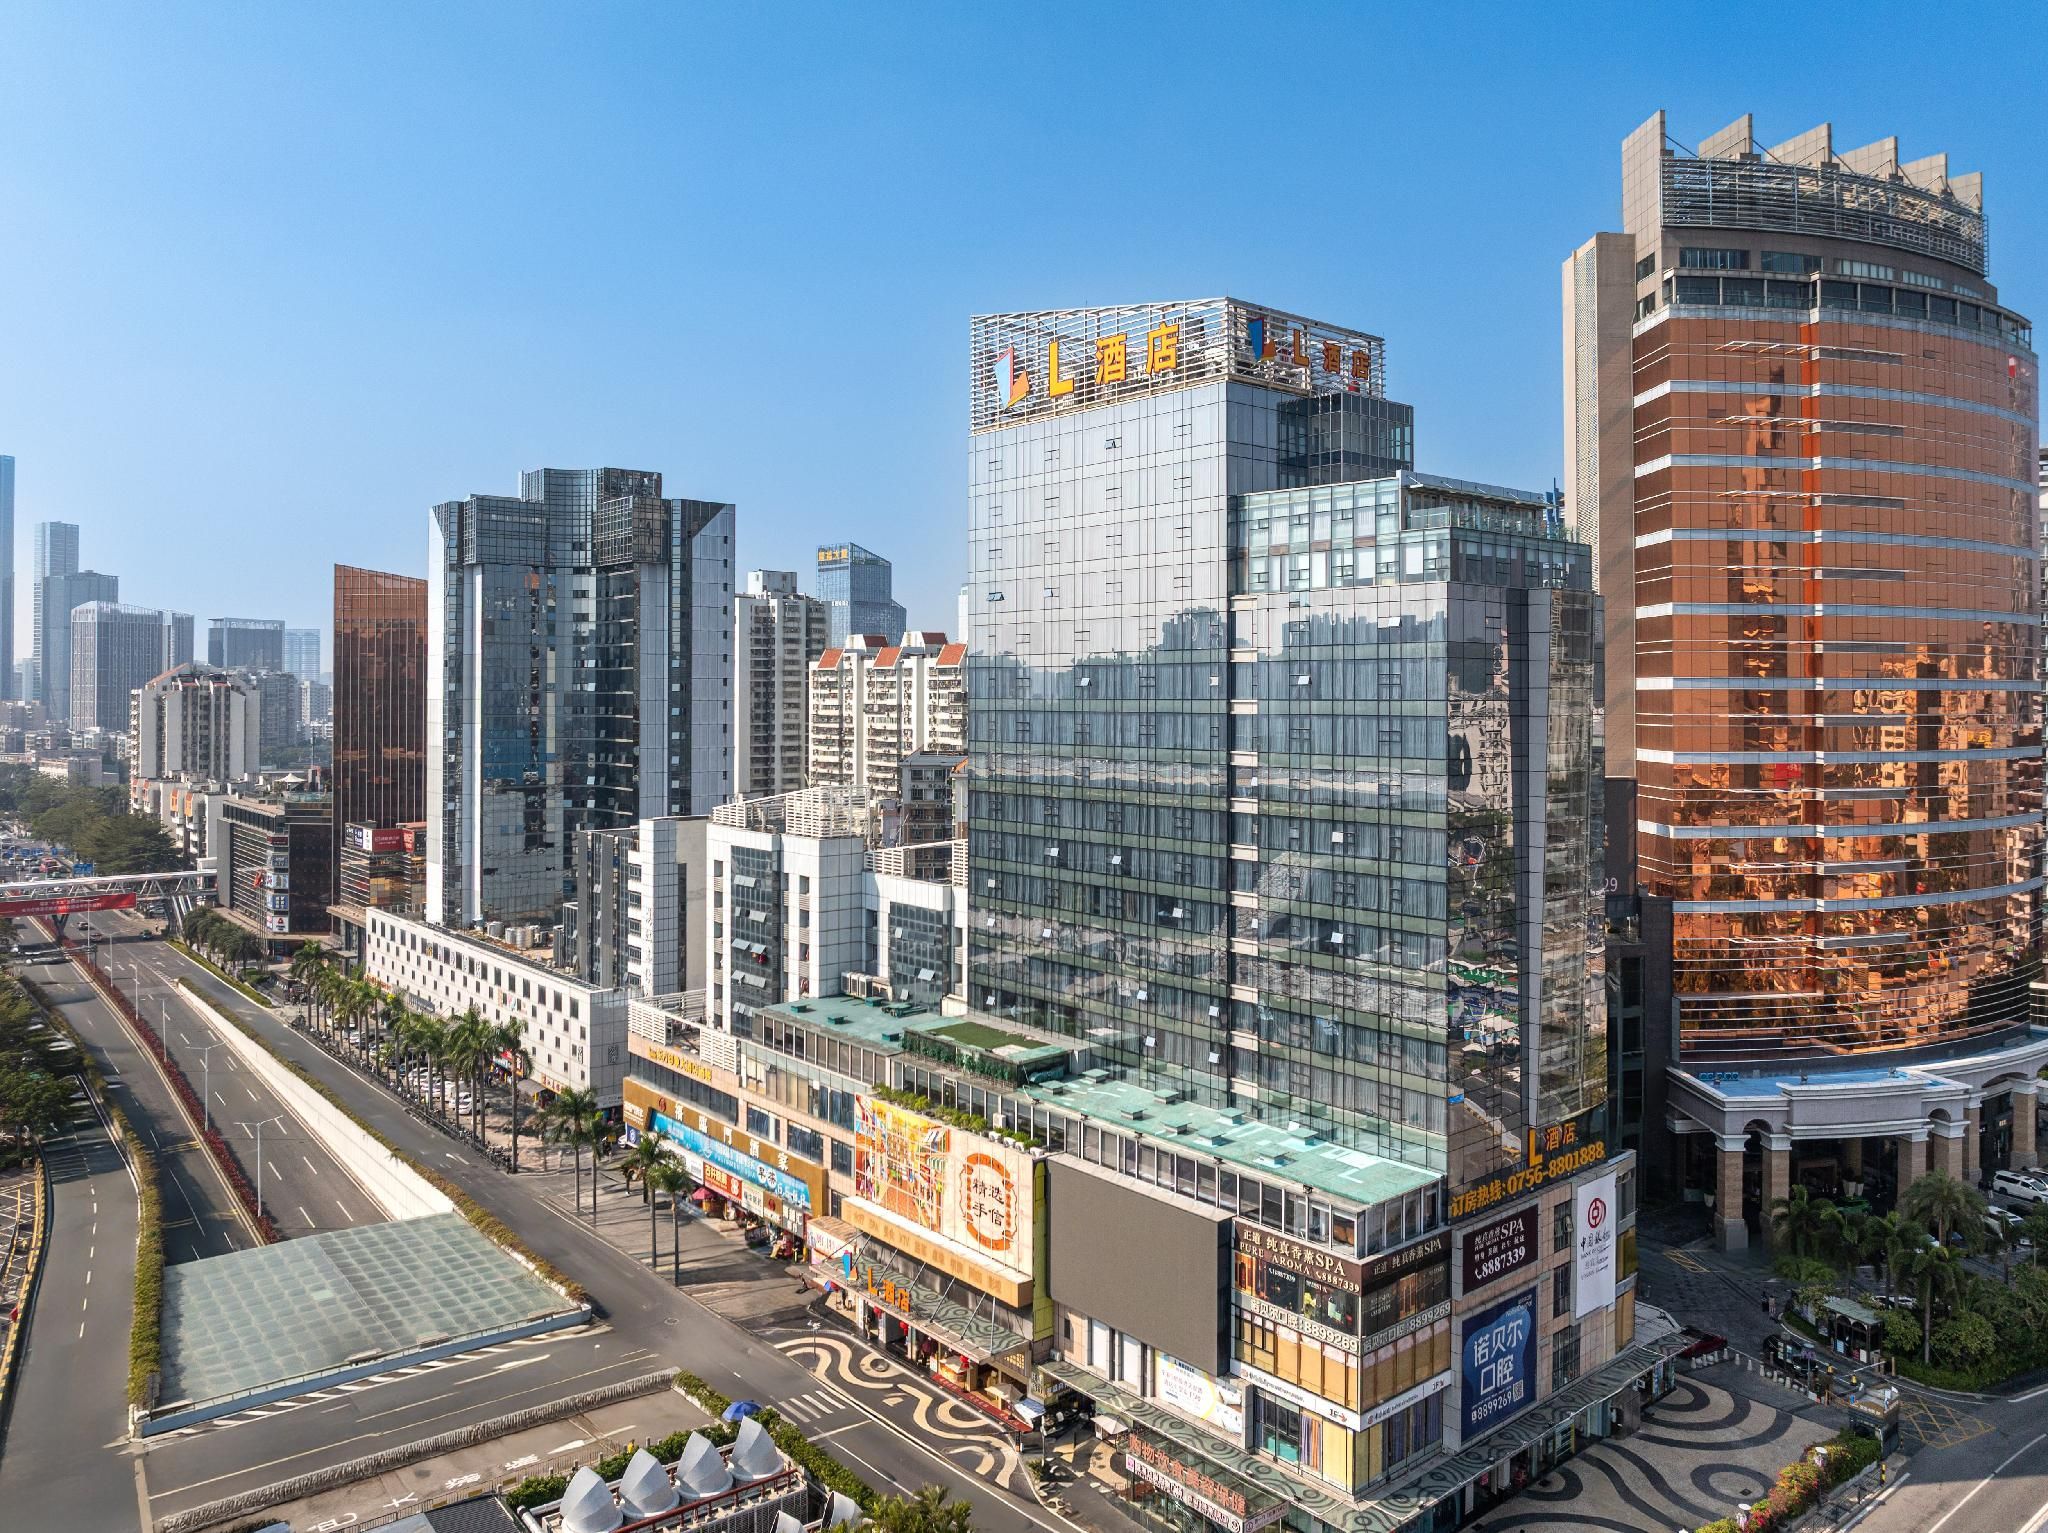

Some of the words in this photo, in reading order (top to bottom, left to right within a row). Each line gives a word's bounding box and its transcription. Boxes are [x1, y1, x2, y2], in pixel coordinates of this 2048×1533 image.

[972, 1202, 1005, 1227] 手信
[1239, 1241, 1265, 1258] PURE
[1272, 1255, 1311, 1277] AROMA
[1321, 1271, 1361, 1292] 8887339
[1481, 1246, 1526, 1278] 8887339
[1474, 1319, 1523, 1368] 诺贝尔
[1480, 1354, 1514, 1396] 口腔
[1477, 1391, 1512, 1420] 8899269
